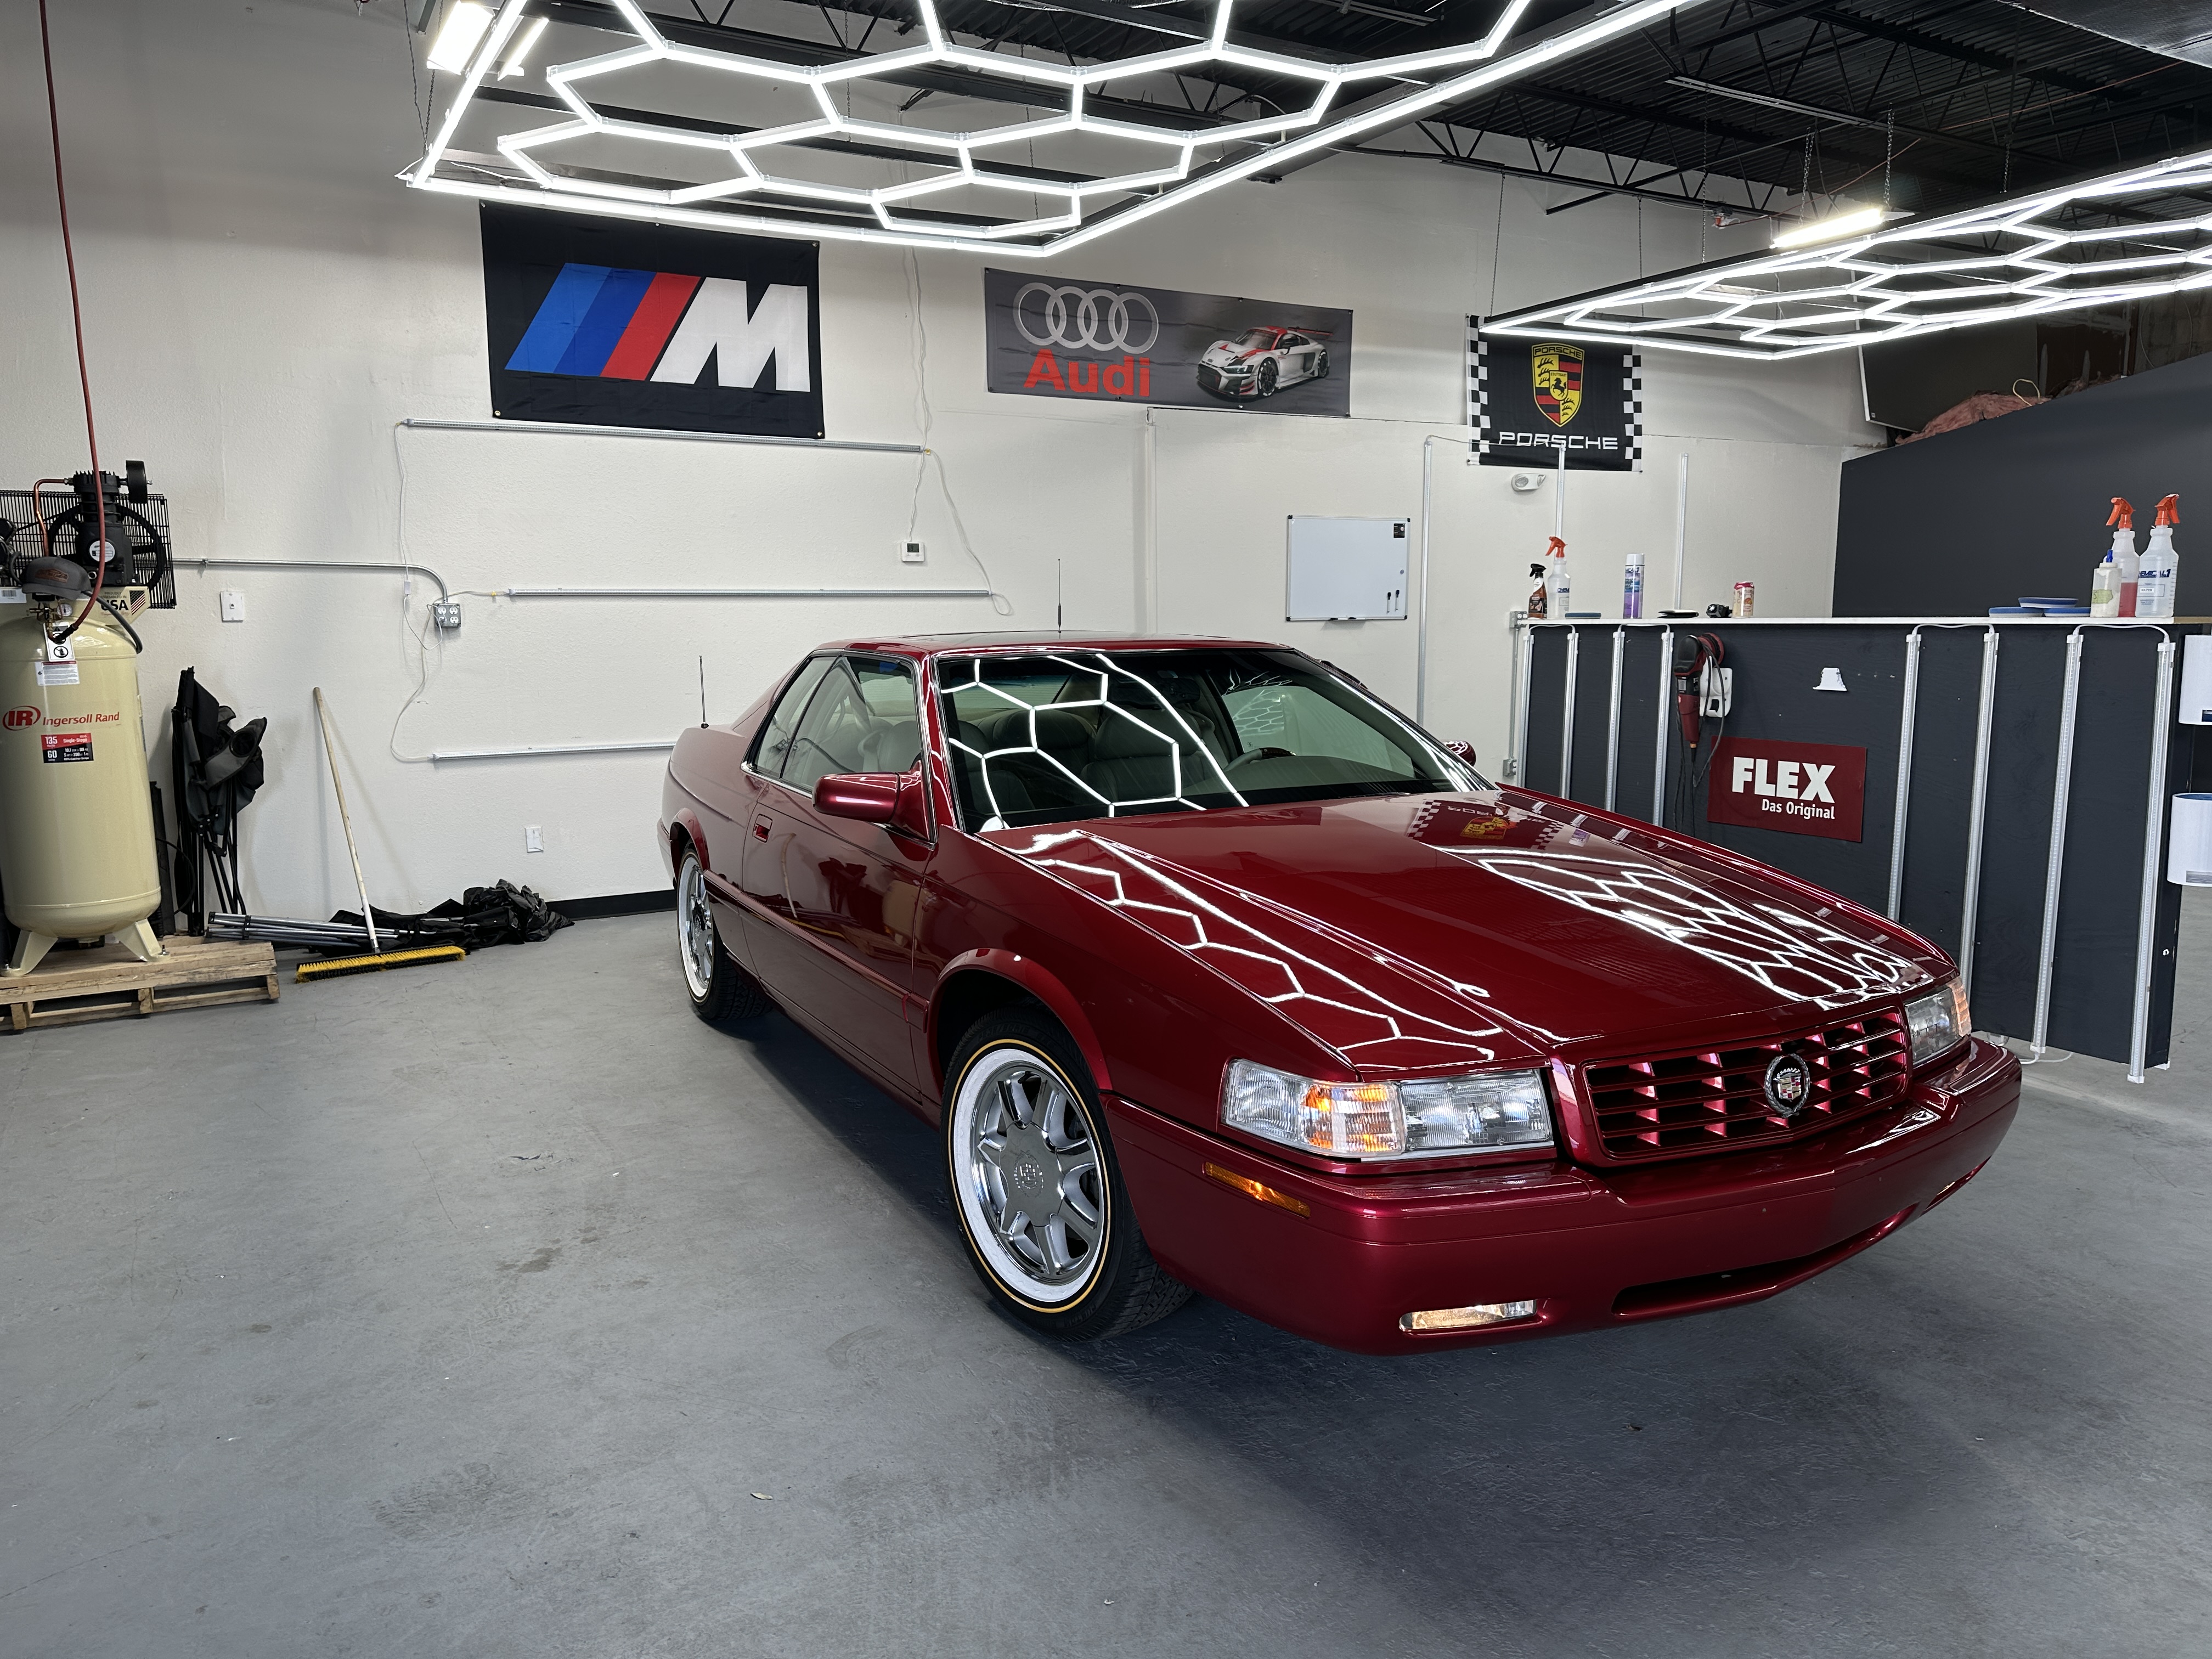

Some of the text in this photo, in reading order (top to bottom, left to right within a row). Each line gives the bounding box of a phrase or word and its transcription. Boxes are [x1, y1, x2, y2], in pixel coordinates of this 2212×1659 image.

[650, 276, 811, 392] M
[1534, 346, 1582, 359] PORSCHE
[1024, 348, 1150, 397] Audi
[1499, 431, 1618, 450] PORSCHE
[8, 710, 33, 726] IR
[43, 712, 120, 727] Ingersoll Rand
[45, 736, 58, 744] 135
[47, 750, 58, 758] 60
[1732, 757, 1836, 804] FLEX
[1762, 798, 1835, 820] Das Original
